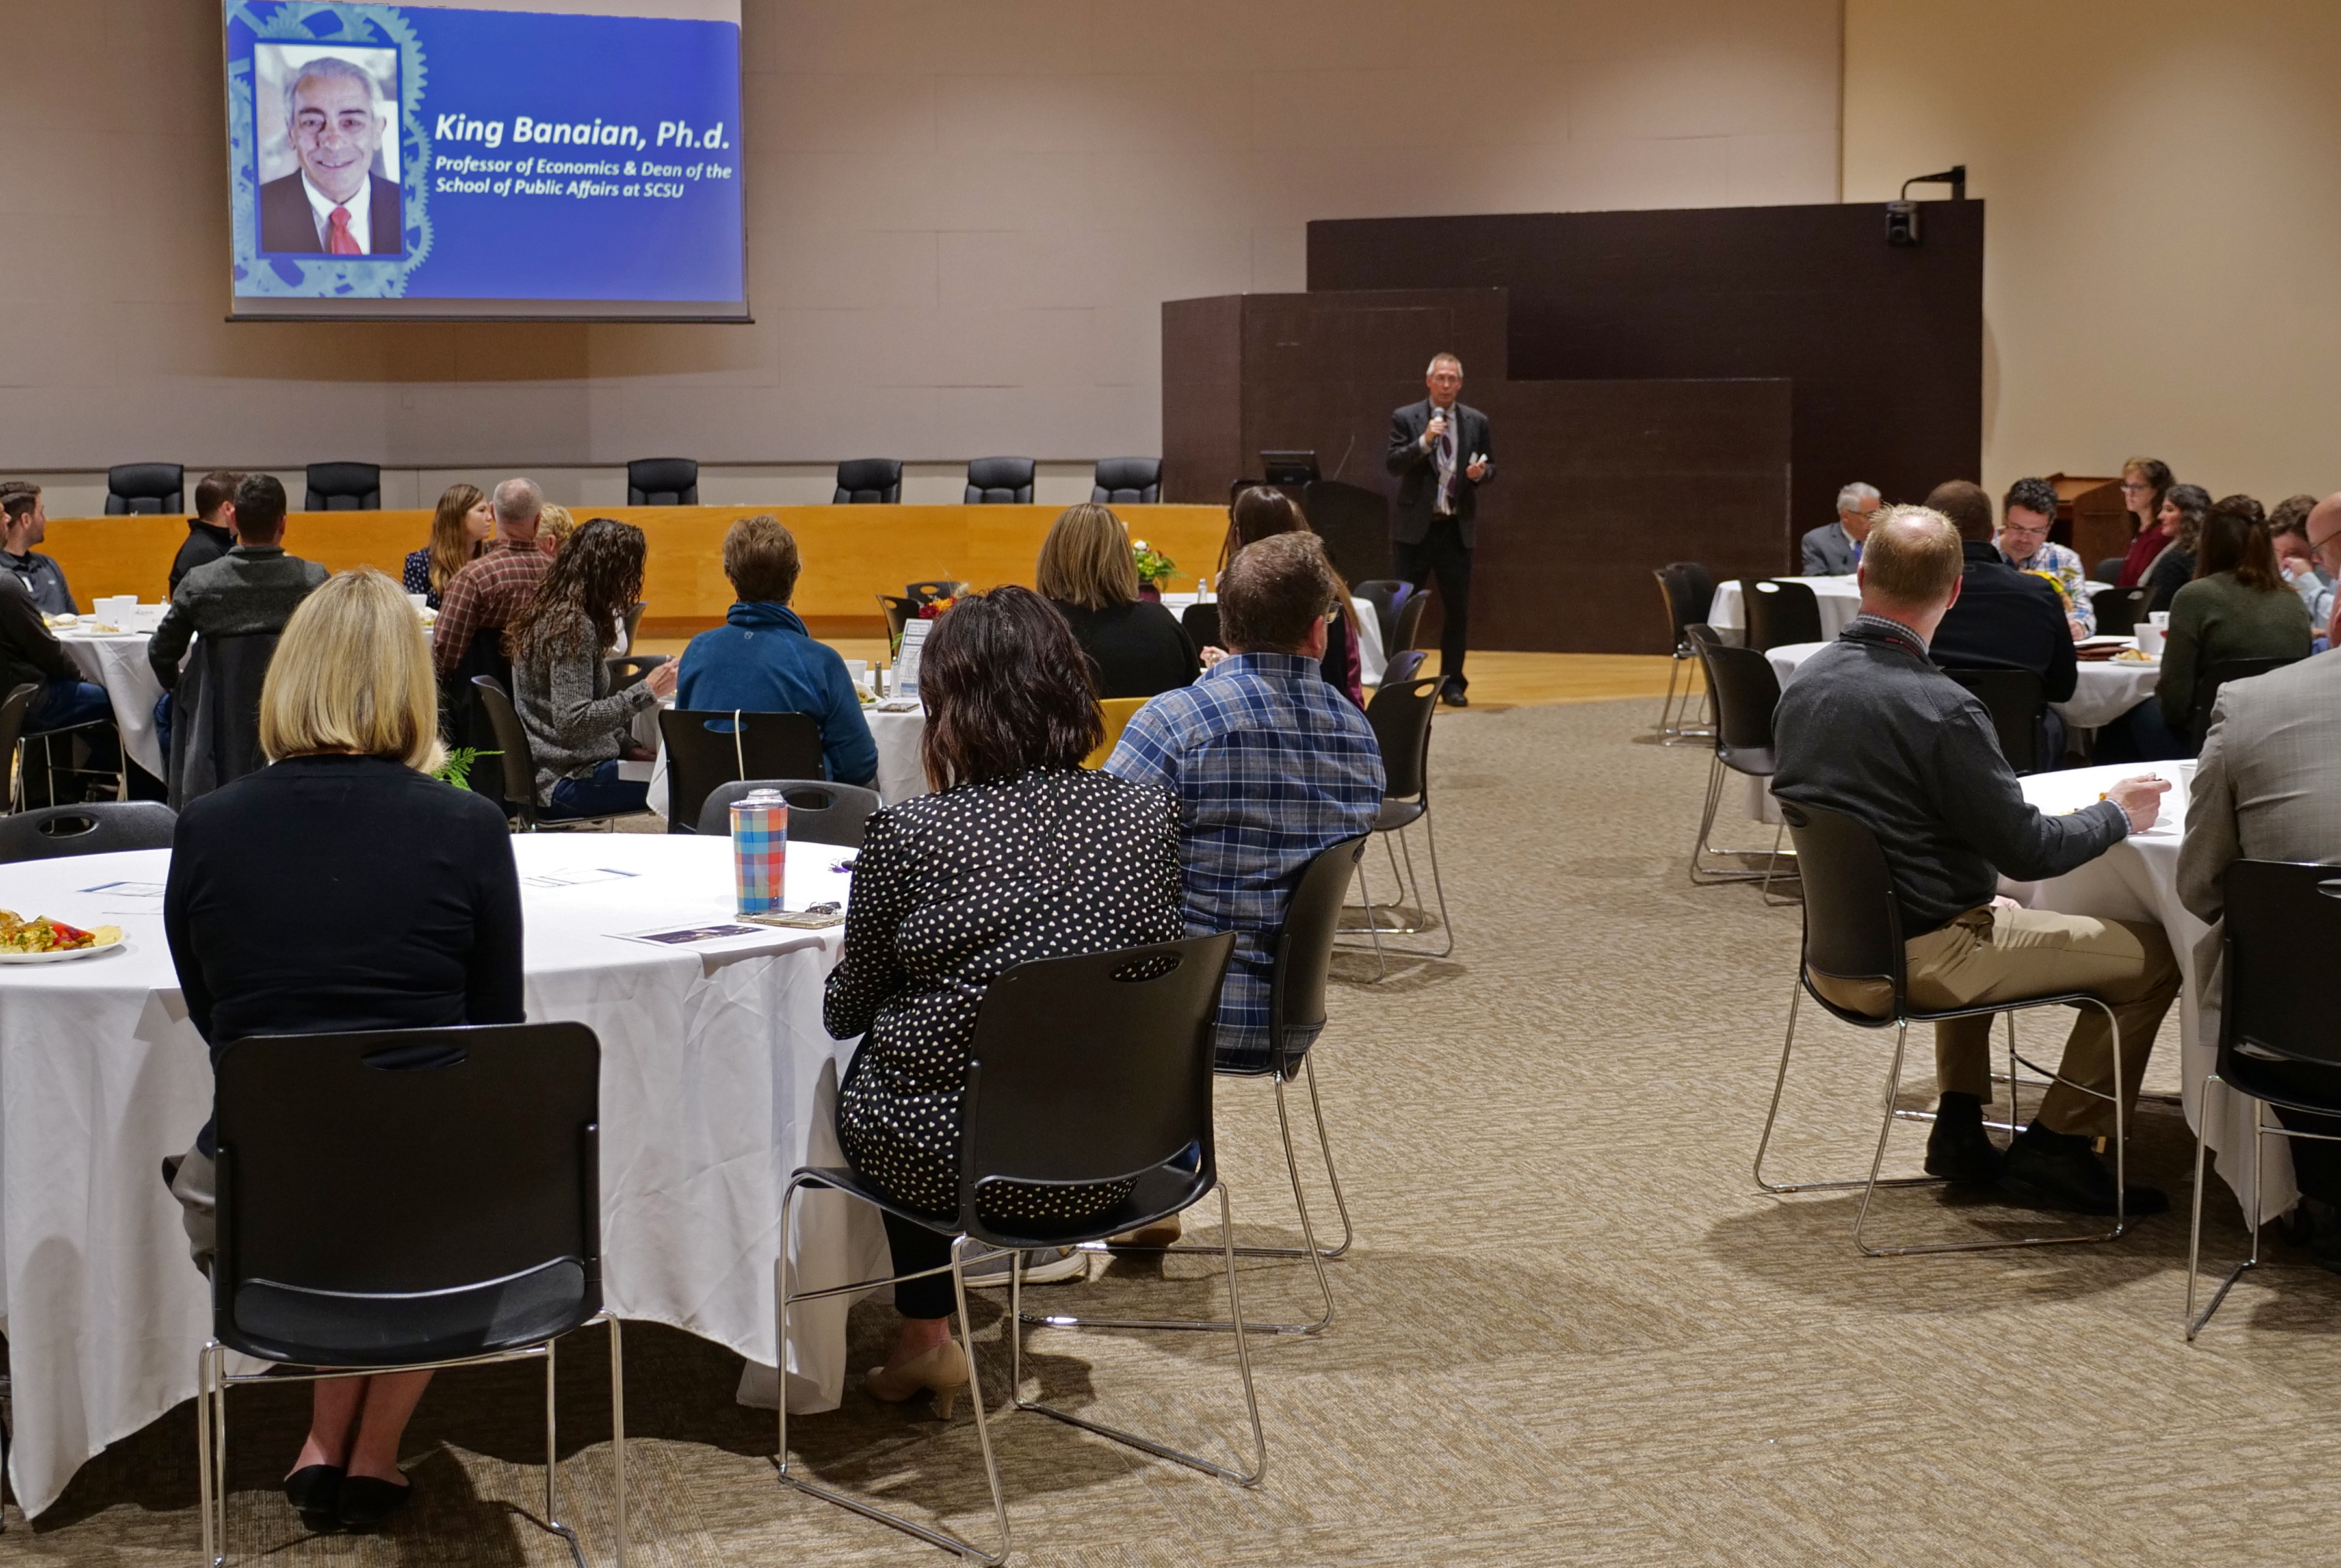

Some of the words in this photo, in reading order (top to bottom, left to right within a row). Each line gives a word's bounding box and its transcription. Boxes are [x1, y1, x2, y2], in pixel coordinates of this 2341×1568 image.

[435, 113, 504, 148] King
[513, 116, 646, 151] Banaian,
[657, 120, 729, 150] Ph.d.
[435, 155, 513, 175] Professor
[516, 157, 534, 176] of
[536, 159, 620, 176] Economics
[623, 161, 637, 176] &
[641, 161, 683, 177] Dean
[685, 163, 704, 181] of
[706, 163, 732, 179] the
[436, 176, 491, 193] School
[493, 177, 512, 197] of
[514, 179, 564, 195] Public
[566, 180, 620, 199] Affairs
[623, 183, 641, 197] at
[643, 183, 685, 198] SCSU
